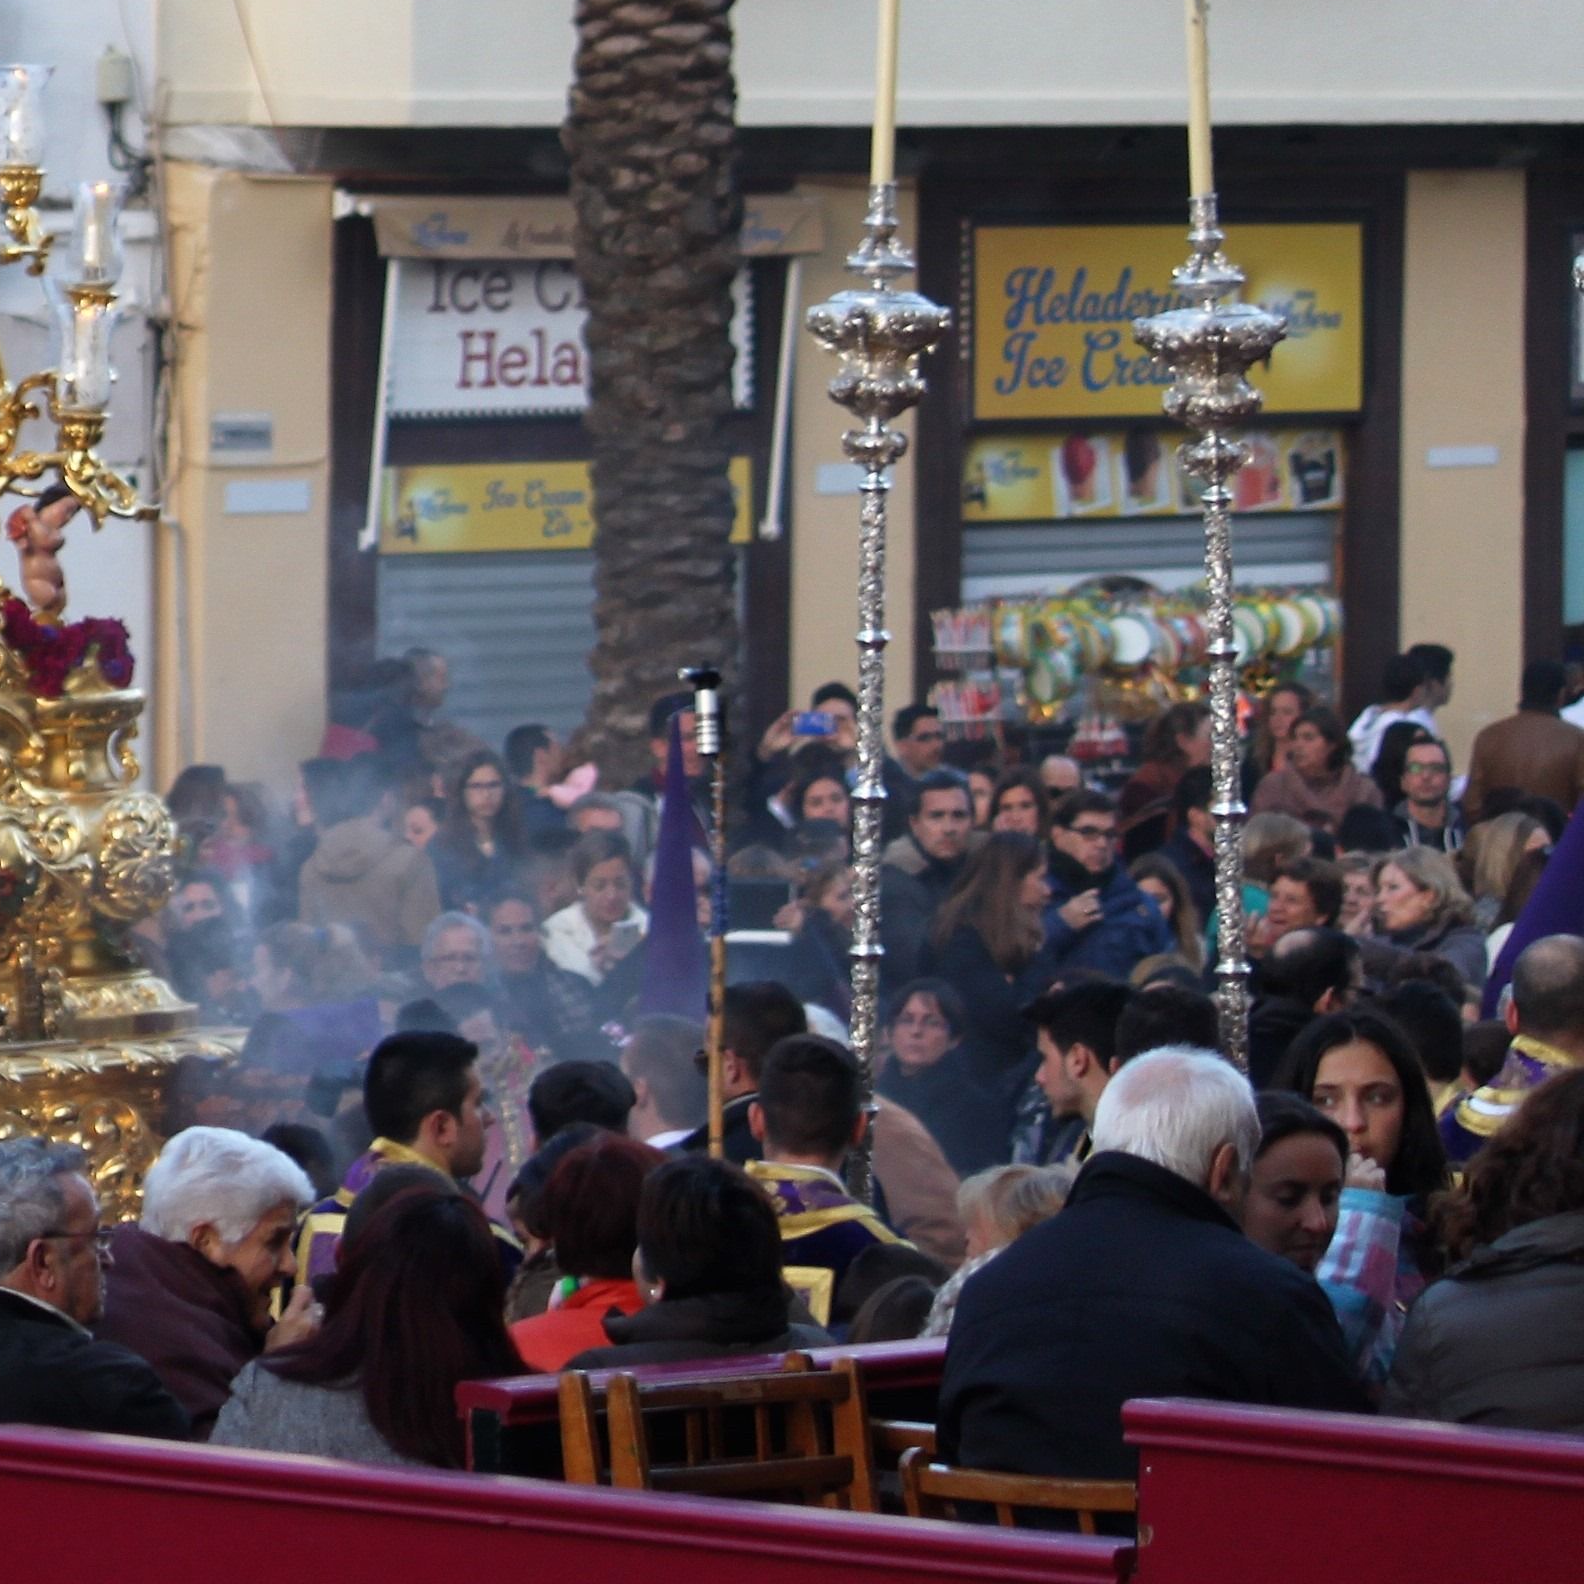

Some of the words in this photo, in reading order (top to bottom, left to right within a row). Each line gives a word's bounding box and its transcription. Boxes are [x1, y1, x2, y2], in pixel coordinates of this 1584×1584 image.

[427, 259, 514, 314] Ice
[456, 328, 583, 389] Hela
[995, 331, 1069, 396] Ice
